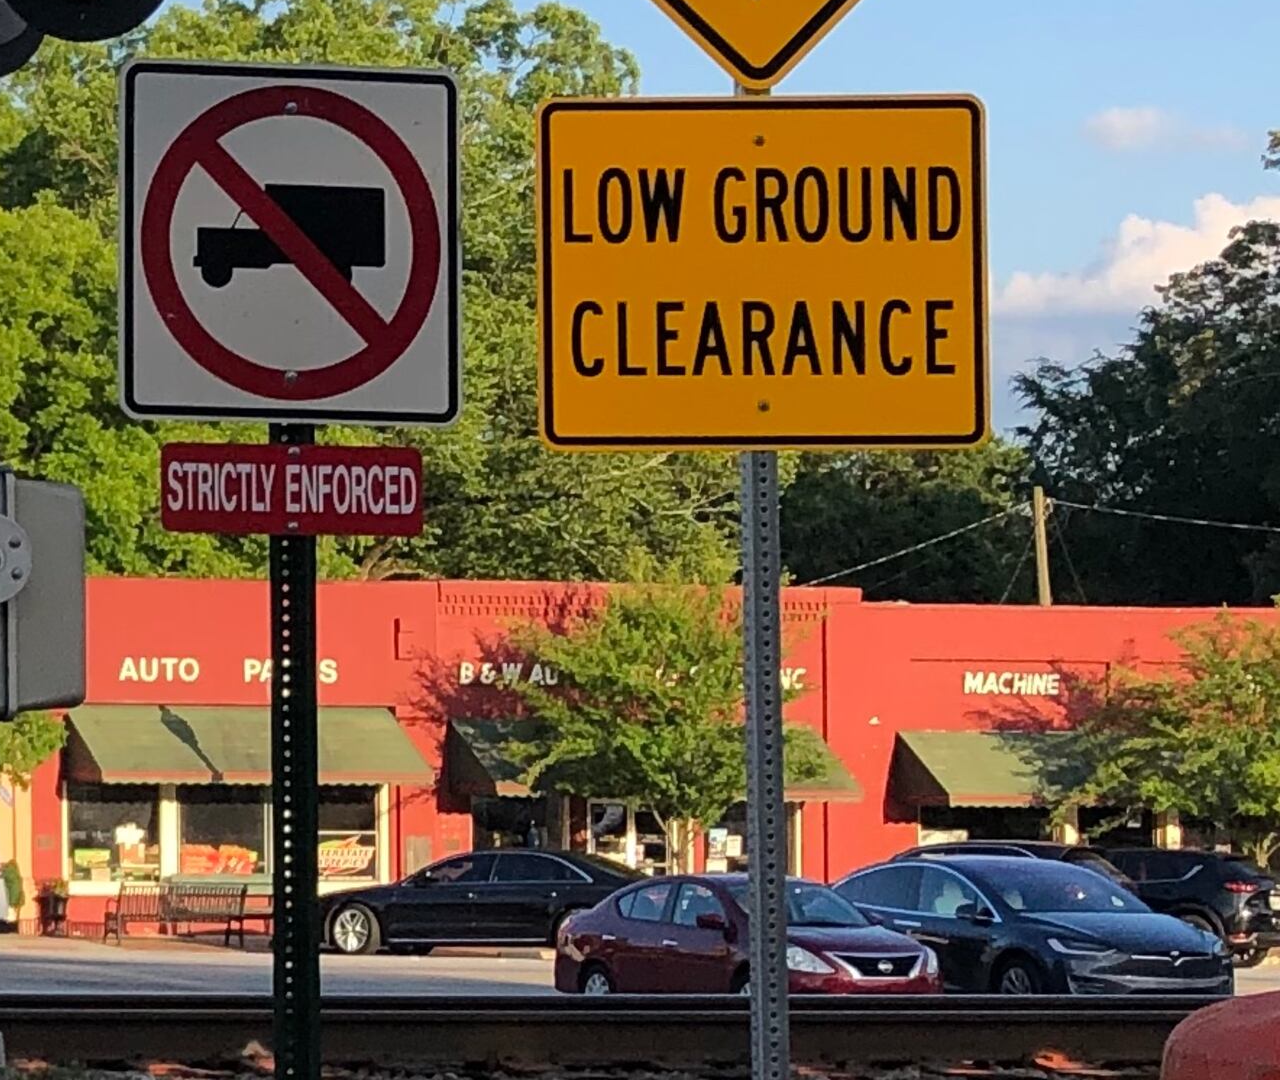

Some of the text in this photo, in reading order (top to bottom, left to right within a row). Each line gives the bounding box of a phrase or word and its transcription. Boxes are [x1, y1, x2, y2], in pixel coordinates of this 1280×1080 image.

[563, 166, 961, 244] LOW GROUND
[571, 299, 956, 377] CLEARANCE
[167, 461, 417, 515] STRICTLY ENFORCED
[119, 657, 338, 684] AUTO PAS
[459, 662, 474, 685] B
[480, 662, 496, 685] &
[501, 663, 523, 685] W
[963, 671, 1061, 696] MACHINE
